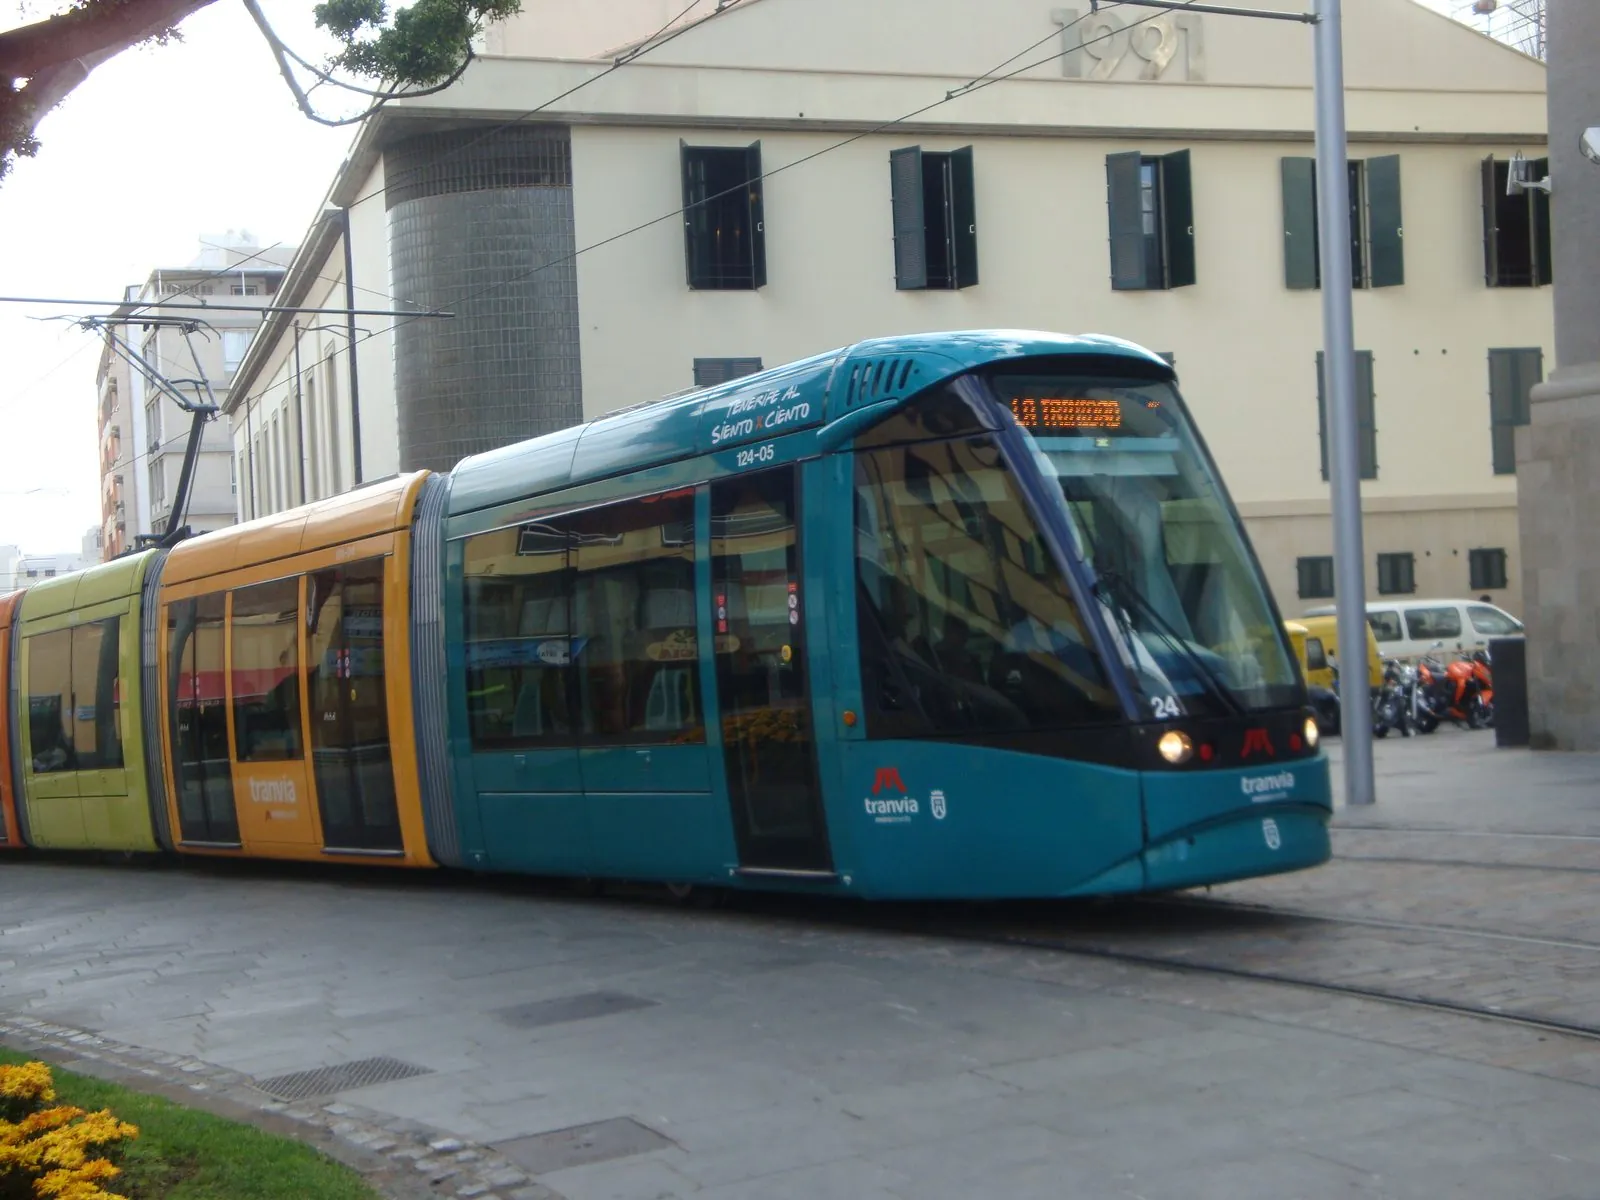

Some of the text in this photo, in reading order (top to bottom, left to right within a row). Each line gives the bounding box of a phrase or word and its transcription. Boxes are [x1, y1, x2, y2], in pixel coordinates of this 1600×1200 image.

[1050, 8, 1204, 81] 1991
[780, 384, 801, 401] AL
[736, 444, 774, 467] 124-05
[1151, 696, 1180, 718] 24
